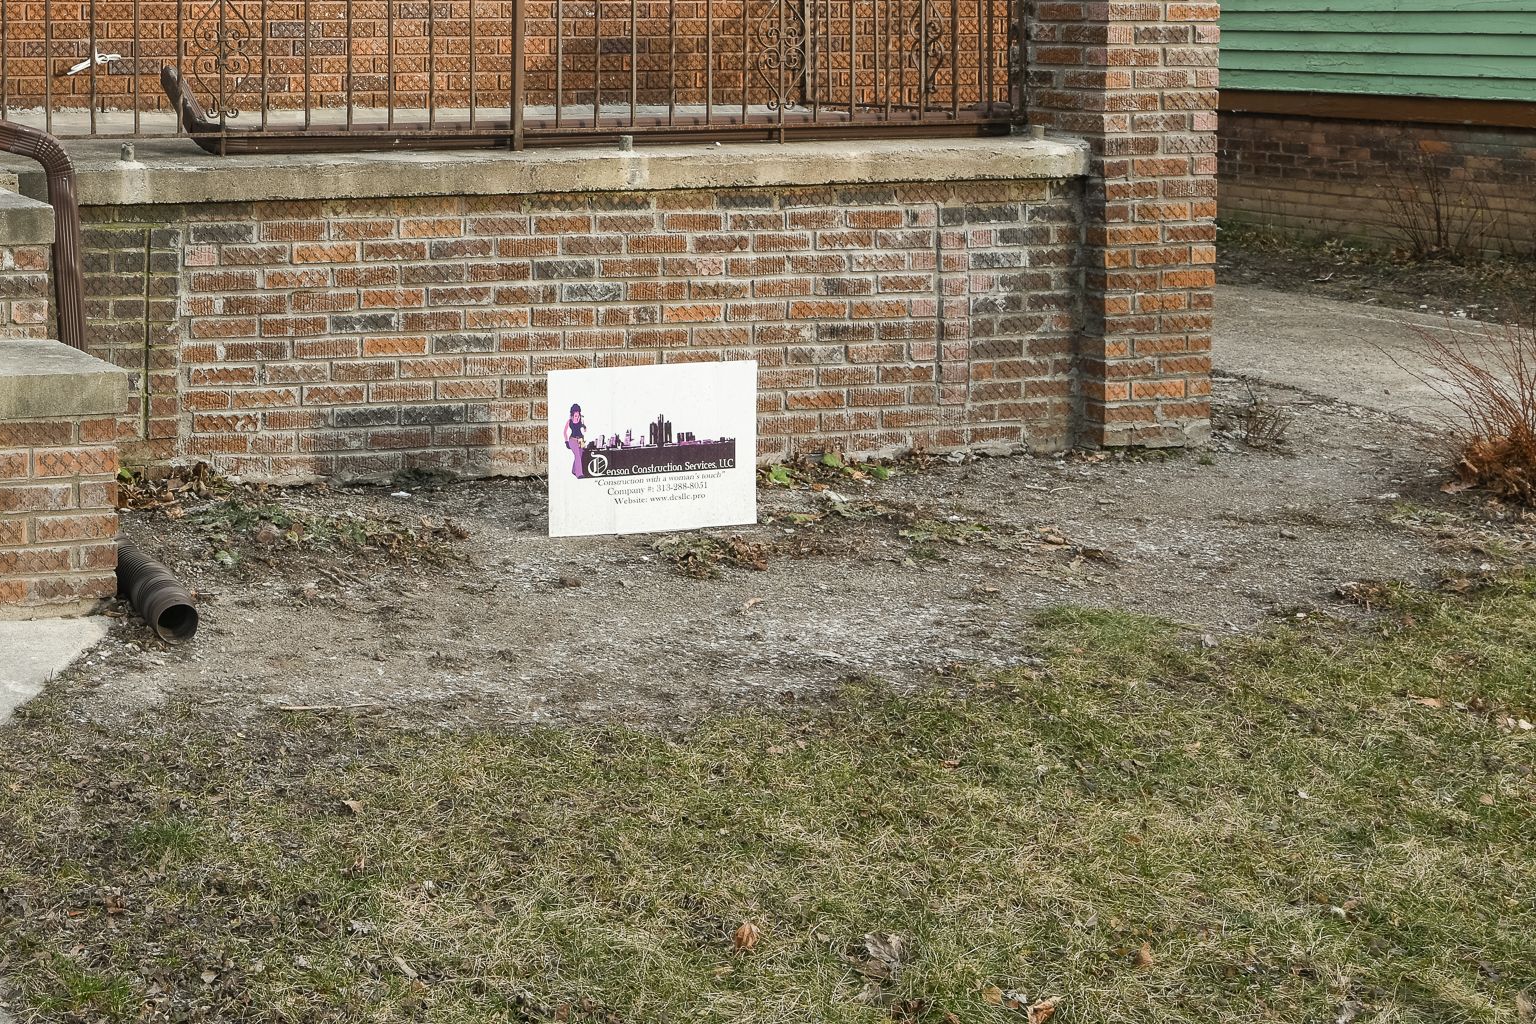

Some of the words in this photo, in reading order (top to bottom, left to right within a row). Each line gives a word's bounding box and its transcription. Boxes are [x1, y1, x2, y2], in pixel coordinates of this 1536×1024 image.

[587, 452, 630, 476] Denson
[632, 461, 683, 475] Construction
[719, 458, 734, 468] LLC
[607, 487, 645, 496] Company
[656, 481, 707, 492] 313-288-8051
[614, 496, 648, 505] Website:
[650, 493, 706, 502] www.dcsllc.pro
